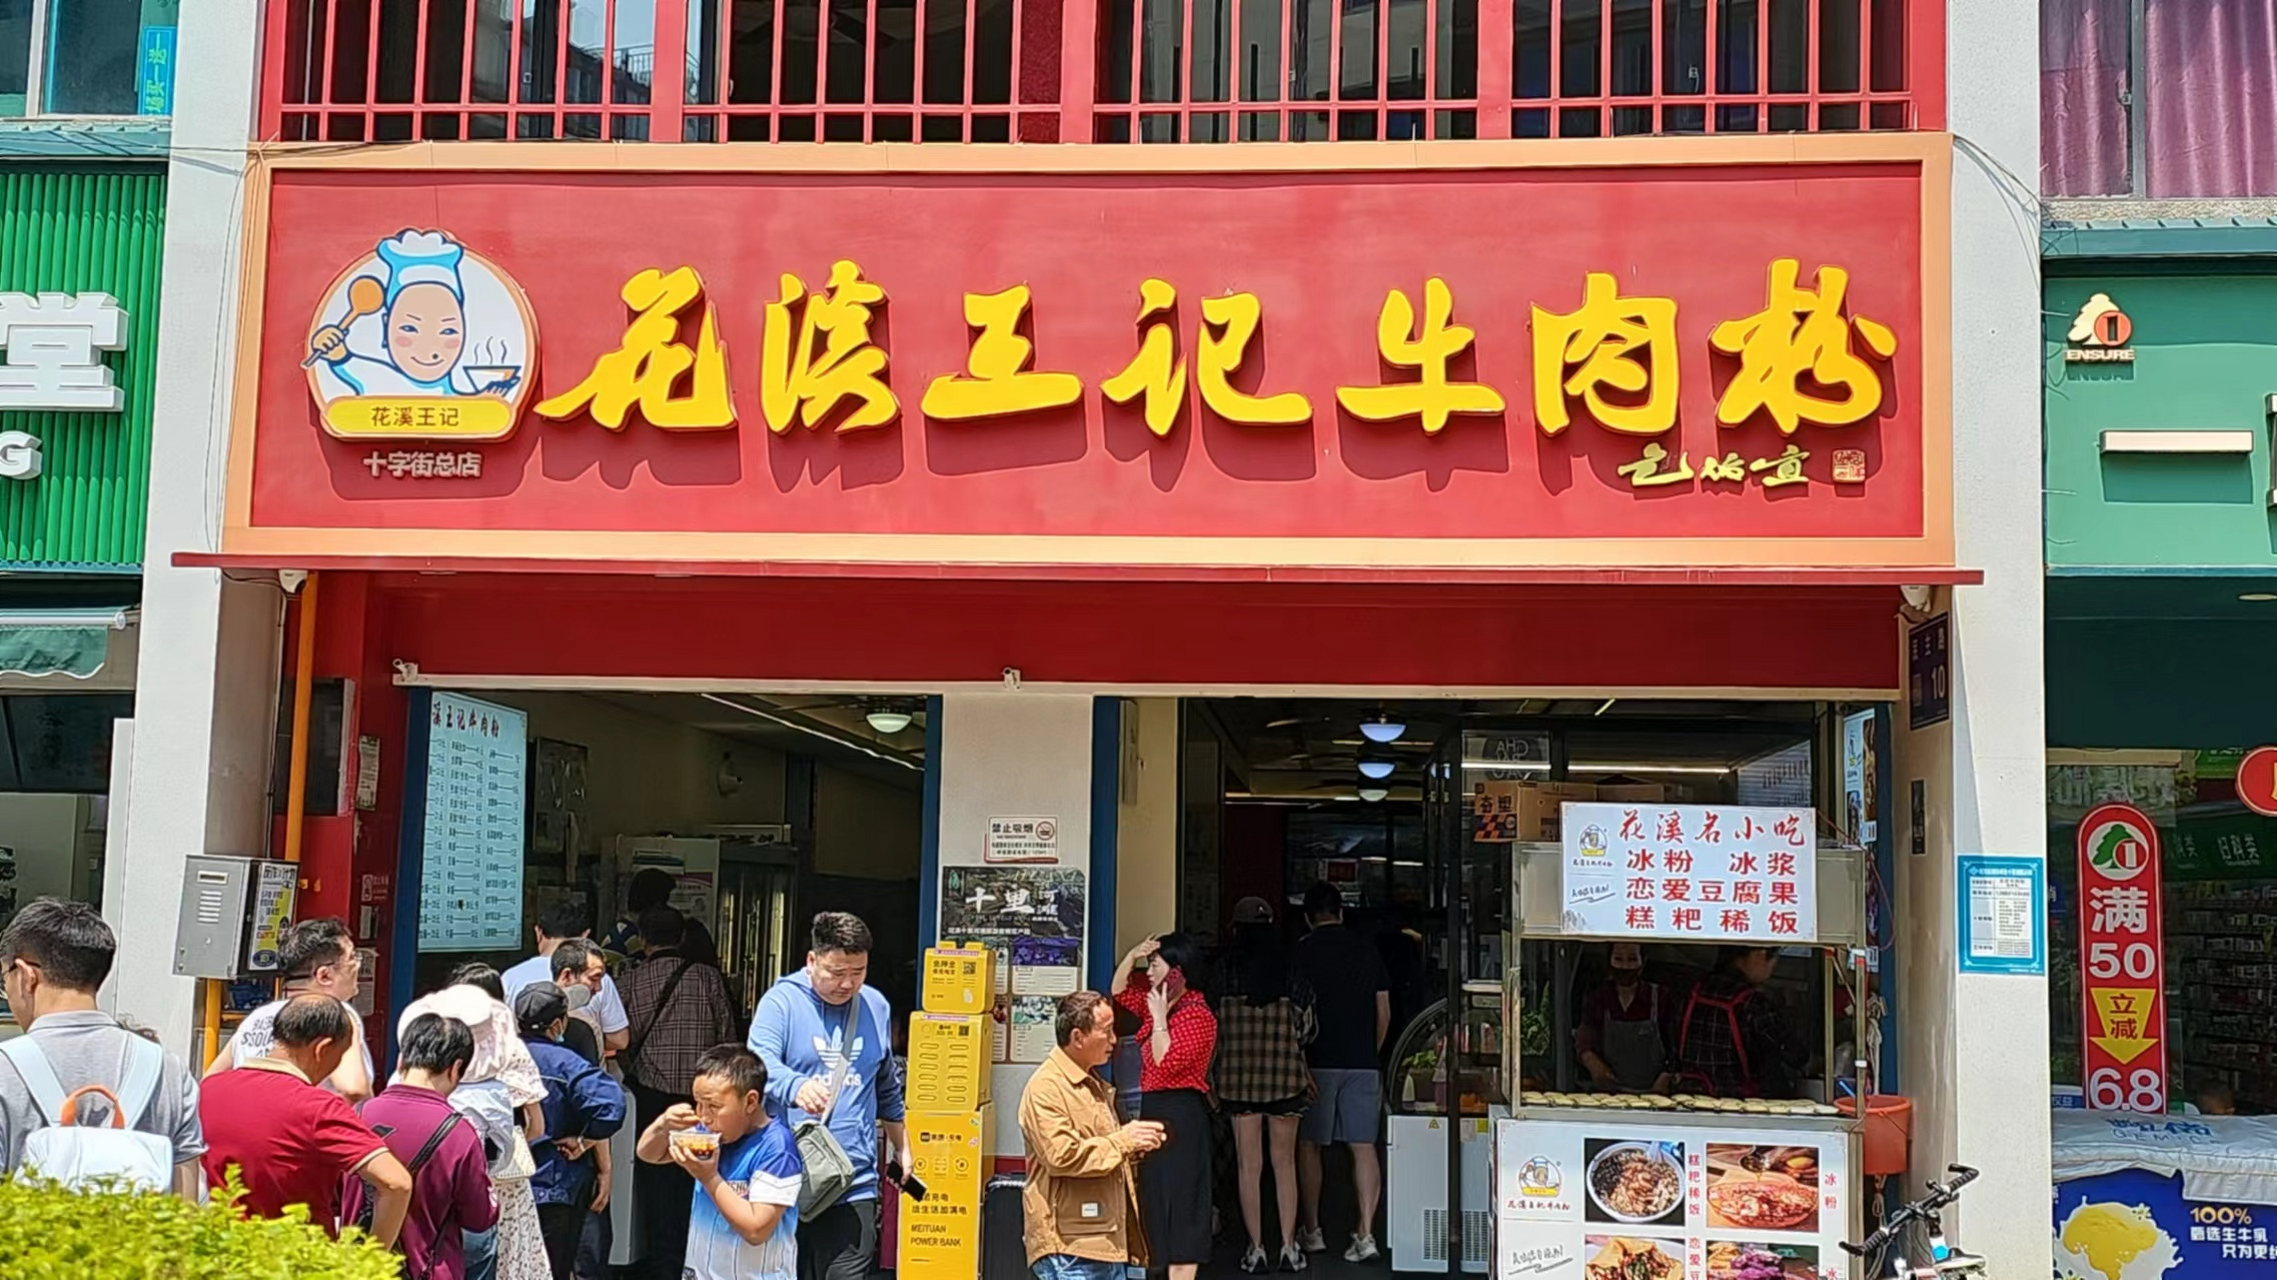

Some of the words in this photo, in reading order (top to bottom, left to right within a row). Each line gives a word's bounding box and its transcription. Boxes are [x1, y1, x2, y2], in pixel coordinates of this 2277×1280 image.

[2066, 350, 2134, 361] ENSURE
[371, 406, 459, 427] 花溪王记
[363, 451, 482, 477] 十字街总店
[1932, 664, 1946, 700] 10
[1619, 809, 1806, 846] 花溪名小吃
[1626, 849, 1694, 874] 冰粉
[1729, 852, 1797, 876] 冰浆
[1626, 877, 1799, 905] 恋爱豆腐果
[1625, 906, 1799, 934] 糕粑稀饭
[2089, 886, 2148, 934] 满
[2089, 942, 2155, 979] 50
[2109, 993, 2138, 1041] 立减
[2090, 1067, 2163, 1112] 6.8
[911, 1224, 946, 1233] MEITUAN
[2190, 1206, 2252, 1225] 100%
[911, 1237, 939, 1246] POWER
[940, 1239, 961, 1247] BANK
